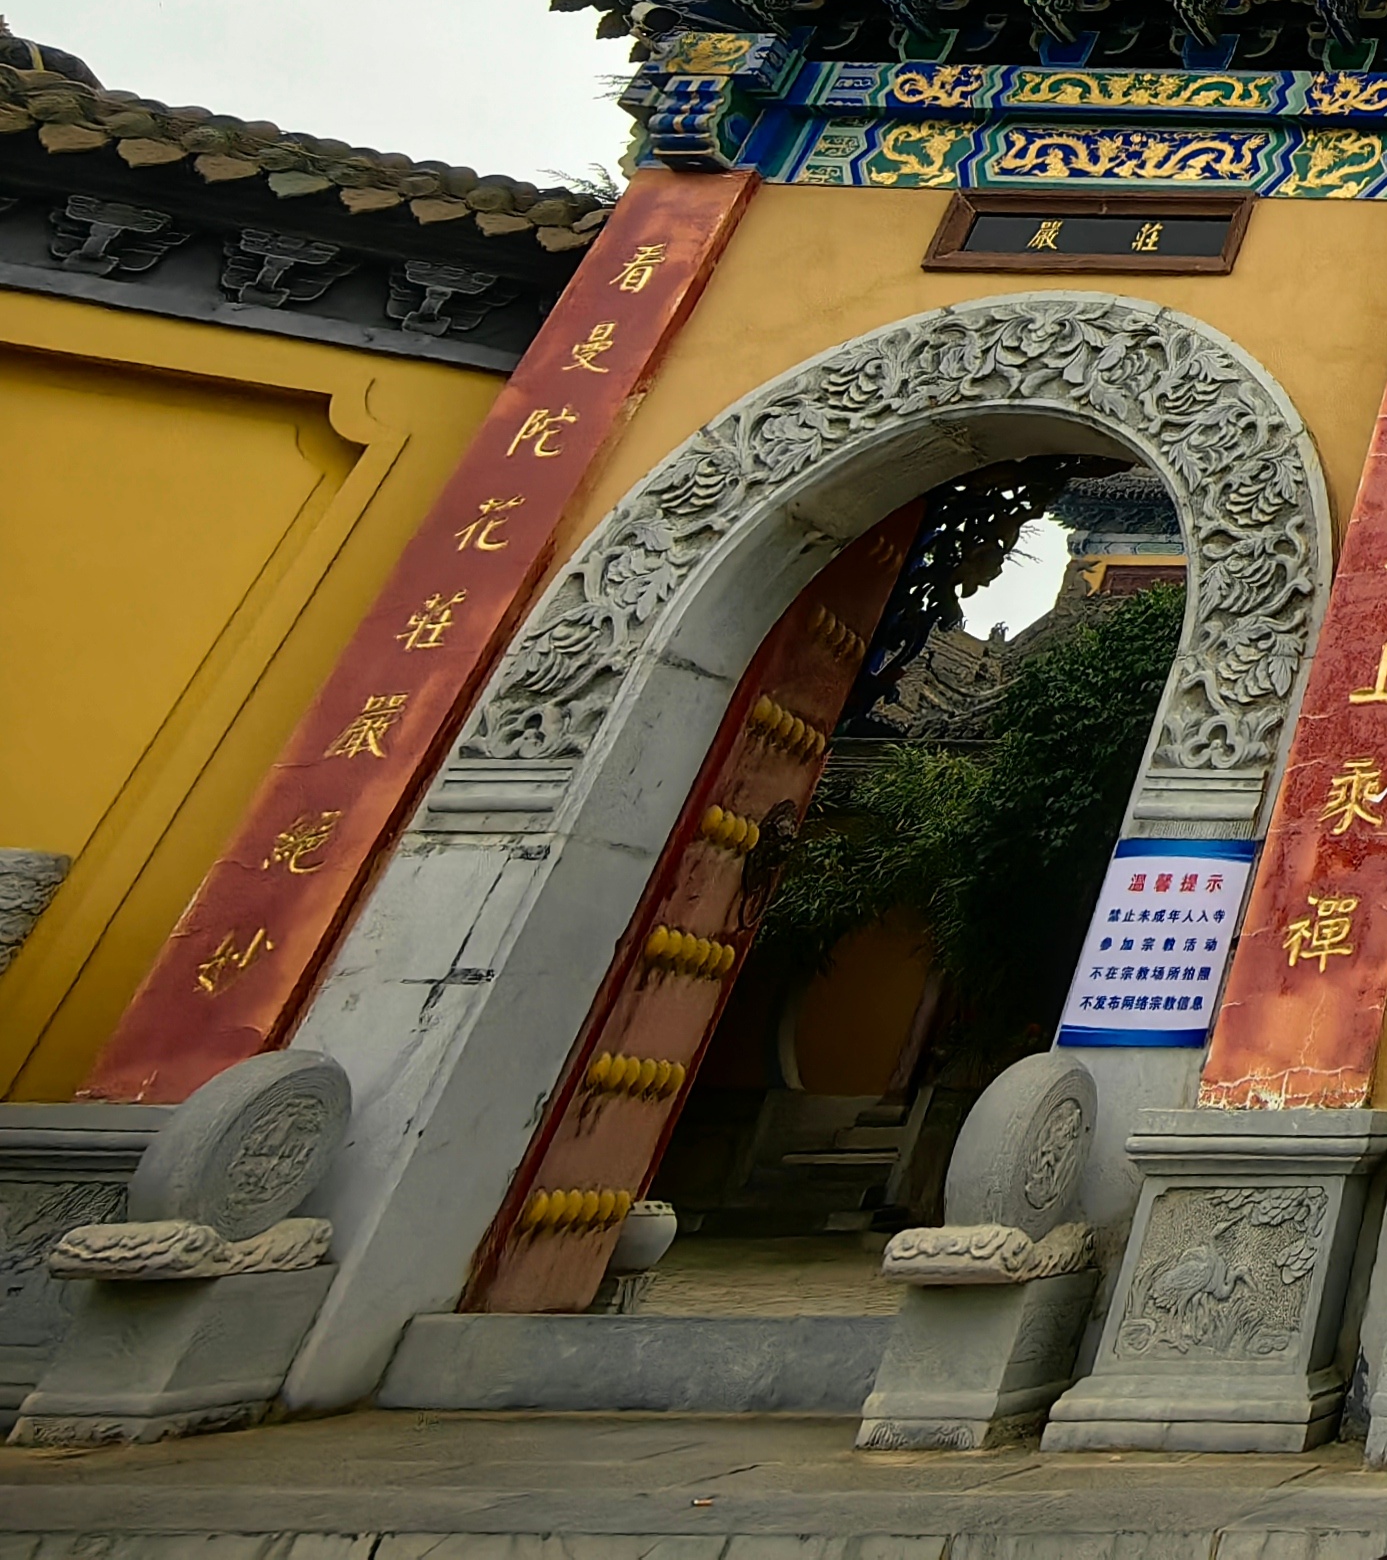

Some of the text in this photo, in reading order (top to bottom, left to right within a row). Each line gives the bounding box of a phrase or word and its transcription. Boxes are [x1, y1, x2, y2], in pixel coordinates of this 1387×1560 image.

[1128, 873, 1224, 893] 温馨提示
[1107, 908, 1226, 924] 禁止未成年人入寺
[1099, 936, 1218, 952] 参加宗教活动
[1089, 966, 1212, 981] 不在宗教场所拍照
[1079, 996, 1203, 1011] 不发布网络宗教信息
